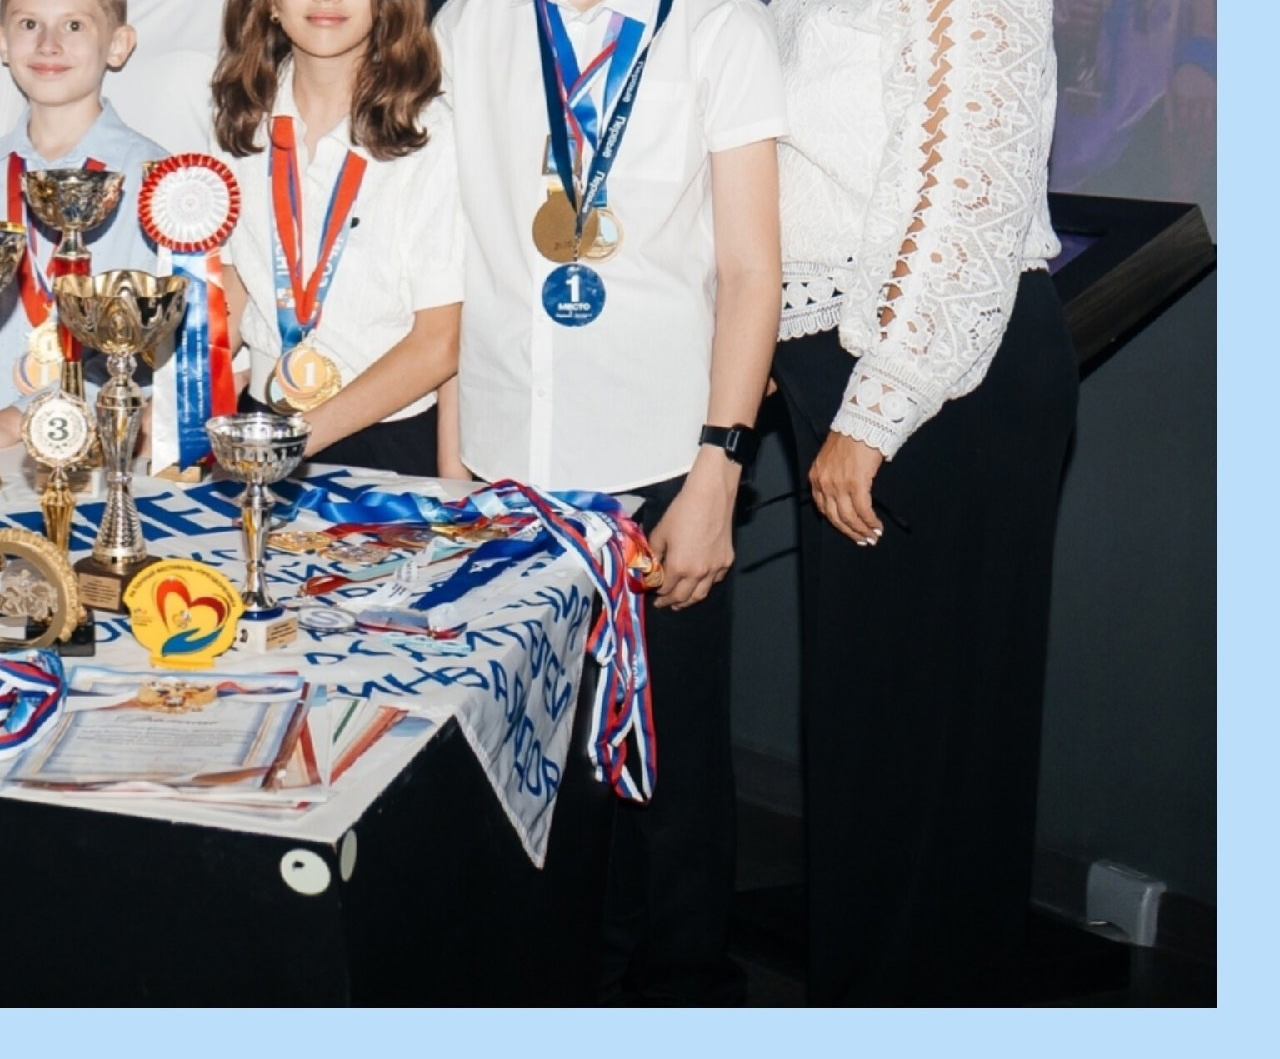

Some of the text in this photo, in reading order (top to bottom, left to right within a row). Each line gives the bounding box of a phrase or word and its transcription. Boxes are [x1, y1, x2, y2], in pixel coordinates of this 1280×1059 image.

[565, 274, 580, 303] 1
[302, 361, 316, 387] 1
[46, 417, 70, 442] 3
